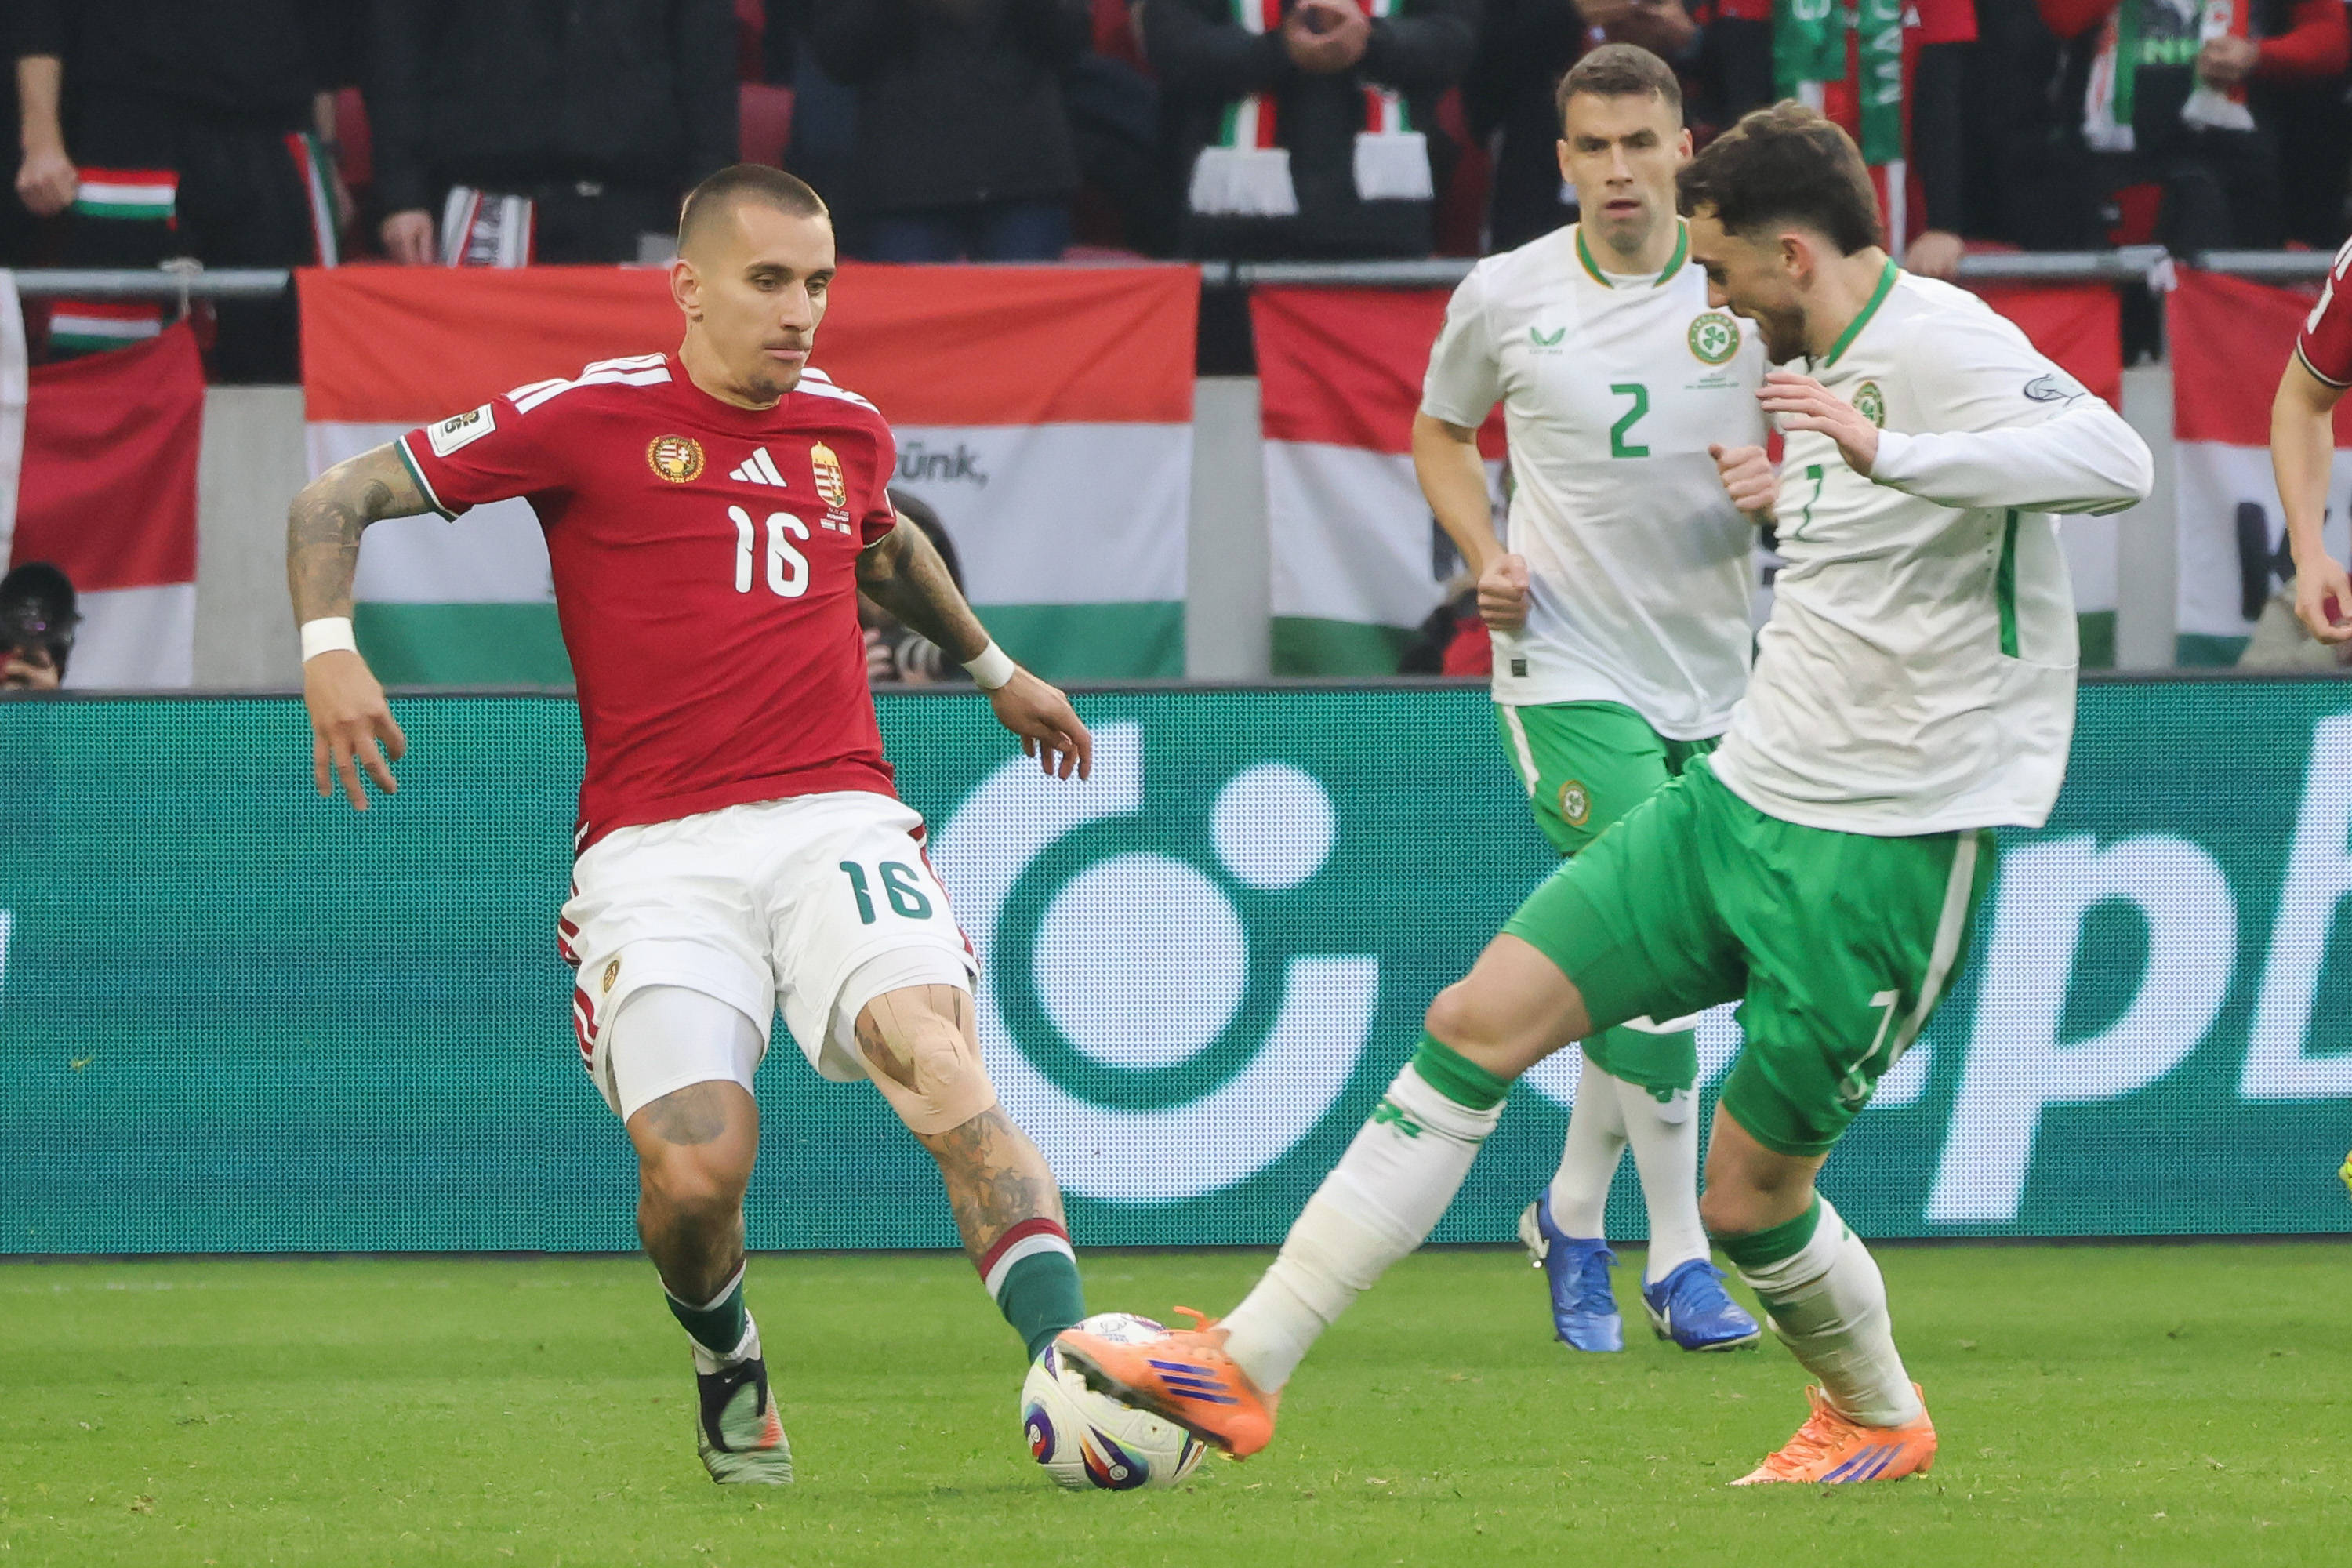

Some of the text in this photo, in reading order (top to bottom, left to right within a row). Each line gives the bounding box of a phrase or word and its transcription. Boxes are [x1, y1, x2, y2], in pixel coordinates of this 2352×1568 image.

[1610, 383, 1650, 459] 2
[895, 441, 989, 488] ünk,
[728, 505, 811, 597] 16
[839, 860, 933, 925] 16
[1849, 989, 1900, 1073] 7
